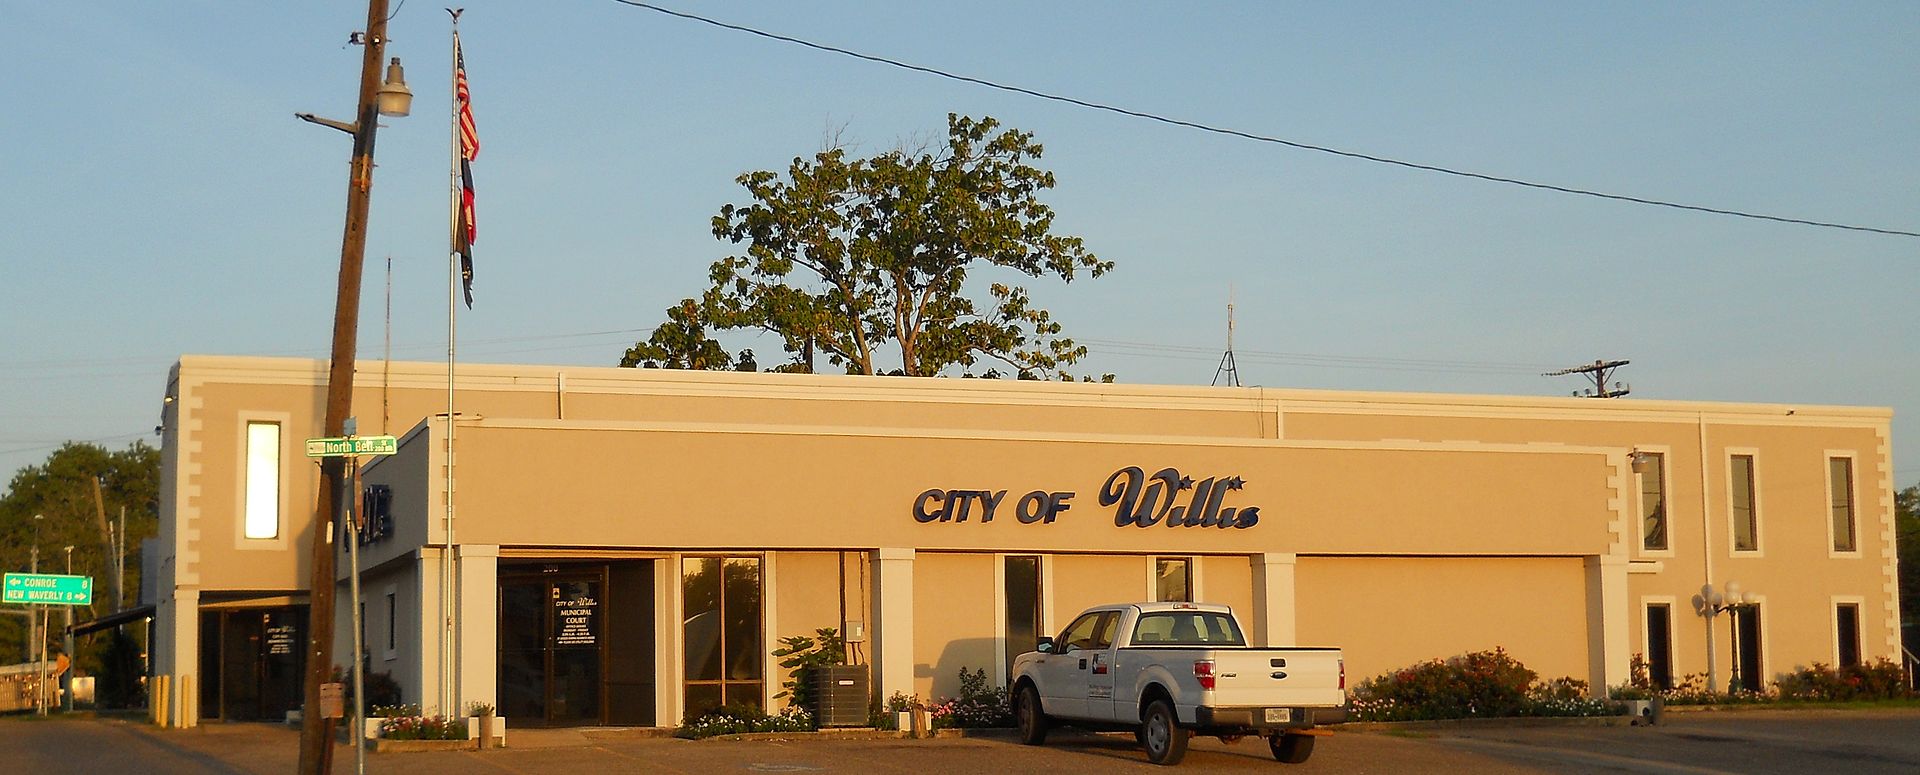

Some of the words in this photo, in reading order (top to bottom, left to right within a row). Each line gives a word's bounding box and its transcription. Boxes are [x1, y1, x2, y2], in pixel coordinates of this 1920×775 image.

[326, 441, 352, 453] North
[355, 440, 373, 452] Bell
[912, 488, 1008, 523] CITY
[1015, 490, 1075, 524] OF
[1098, 465, 1260, 529] Willis
[24, 578, 57, 588] CONROE
[81, 580, 88, 589] 8
[7, 590, 24, 599] NEW
[28, 590, 63, 600] WAVERLY
[66, 592, 73, 600] 8
